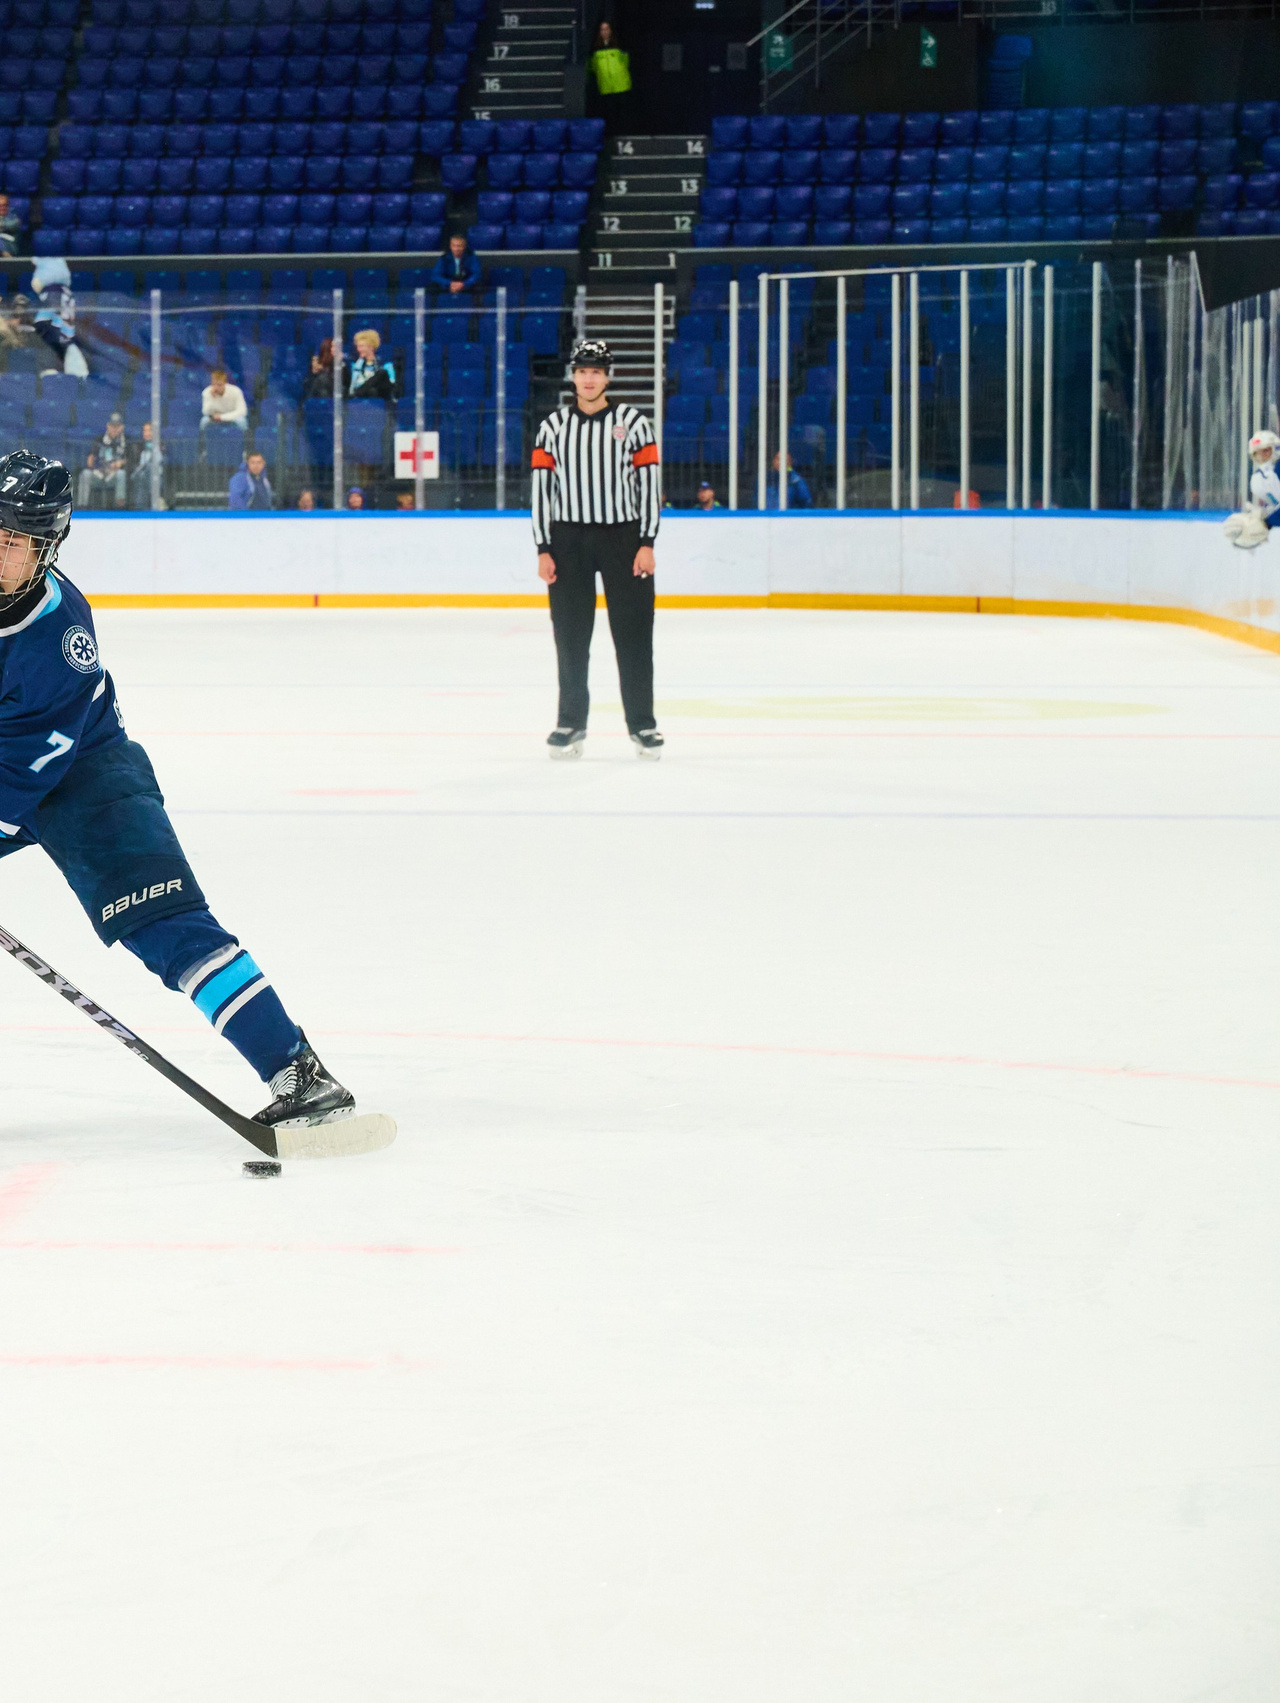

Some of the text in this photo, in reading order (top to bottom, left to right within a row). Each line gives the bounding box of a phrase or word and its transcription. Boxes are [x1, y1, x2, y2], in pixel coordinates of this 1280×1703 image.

[493, 46, 509, 60] 17
[485, 79, 501, 92] 16
[618, 141, 634, 154] 14
[686, 141, 704, 154] 14
[610, 181, 628, 195] 13
[681, 179, 699, 194] 13
[603, 217, 620, 231] 12
[674, 216, 692, 231] 12
[598, 253, 612, 268] 11
[668, 252, 676, 268] 1
[1, 476, 18, 493] 7
[28, 730, 75, 773] 7
[101, 877, 183, 923] BAUER
